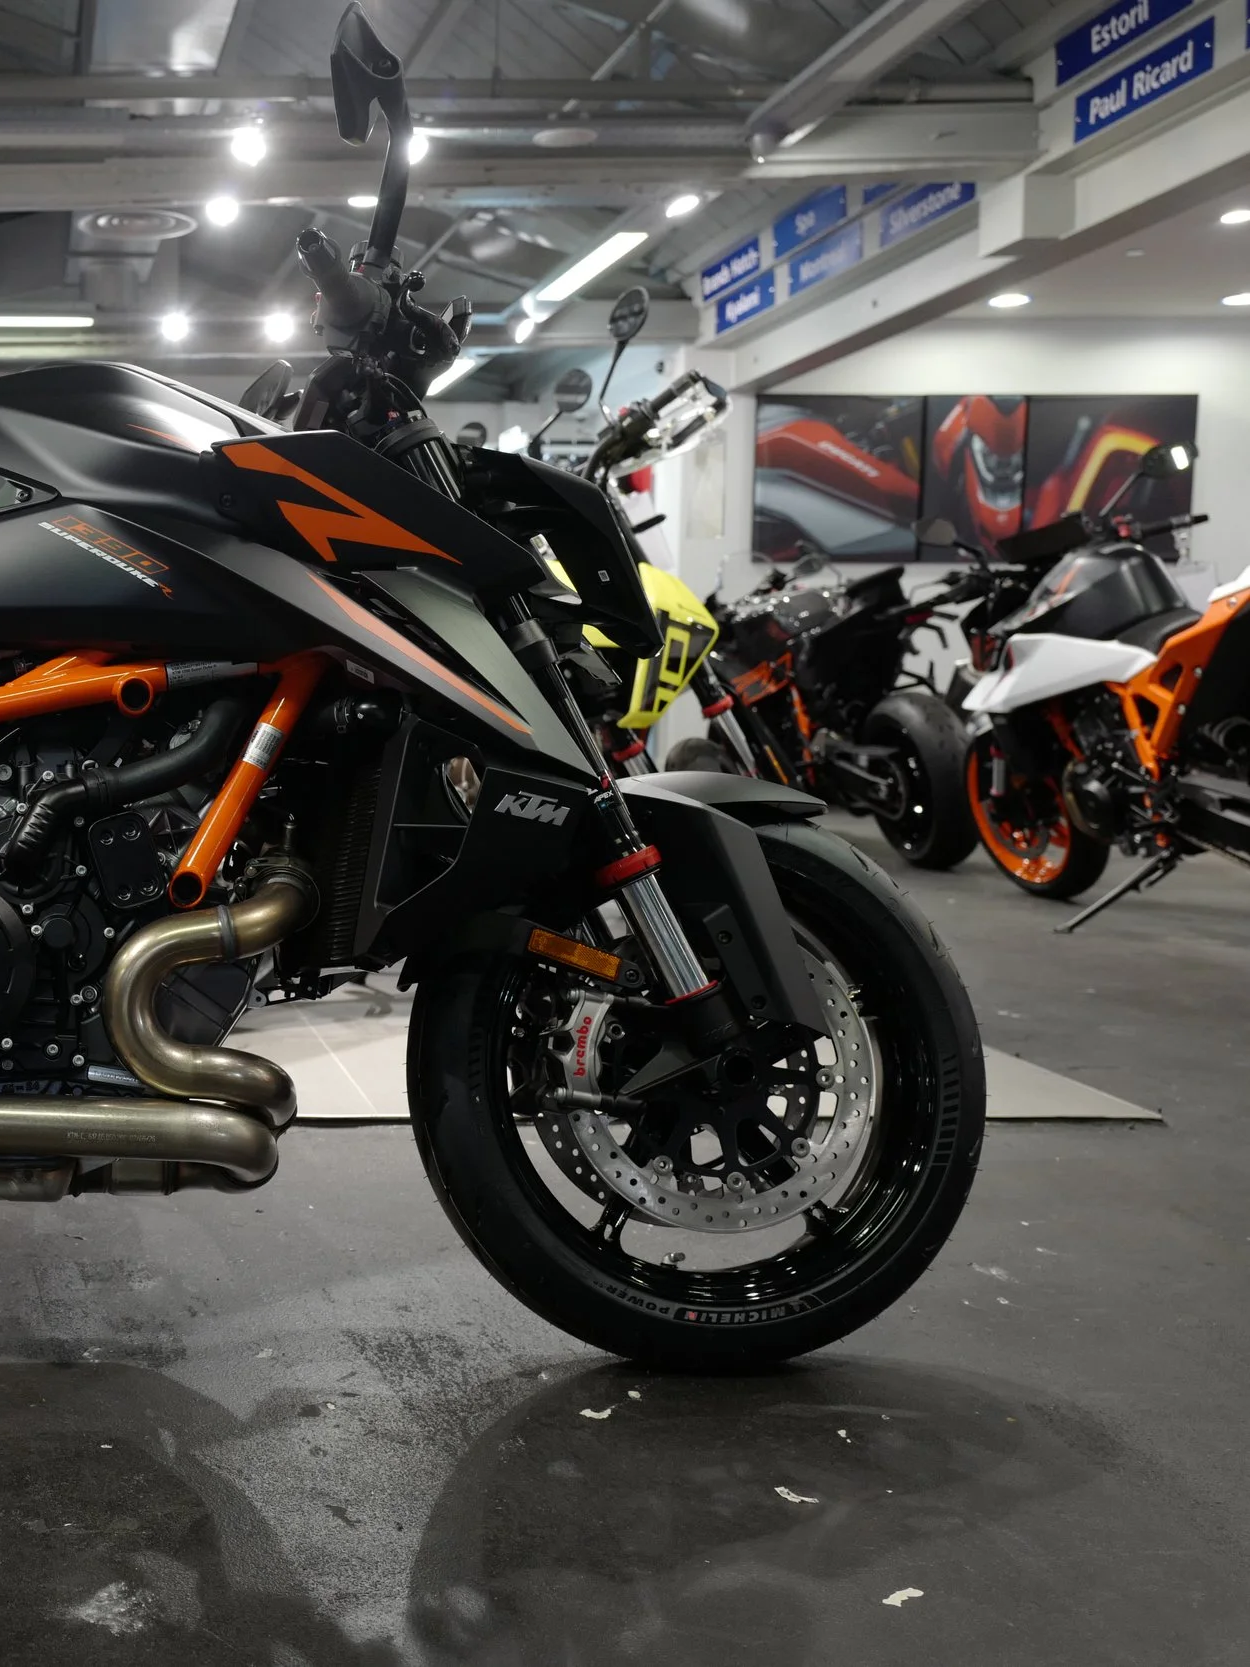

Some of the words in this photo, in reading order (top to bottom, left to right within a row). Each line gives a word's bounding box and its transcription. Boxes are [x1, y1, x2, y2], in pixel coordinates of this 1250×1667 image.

[1090, 0, 1150, 54] Estoril
[1088, 78, 1126, 125] Paul
[1132, 41, 1196, 102] Ricard
[794, 210, 816, 236] Spa
[888, 181, 962, 235] Silverstone
[493, 790, 571, 827] KTM
[592, 790, 615, 805] APEX
[573, 1015, 594, 1077] brembo
[608, 1285, 671, 1316] POWER
[684, 1305, 786, 1323] MICHELIN
